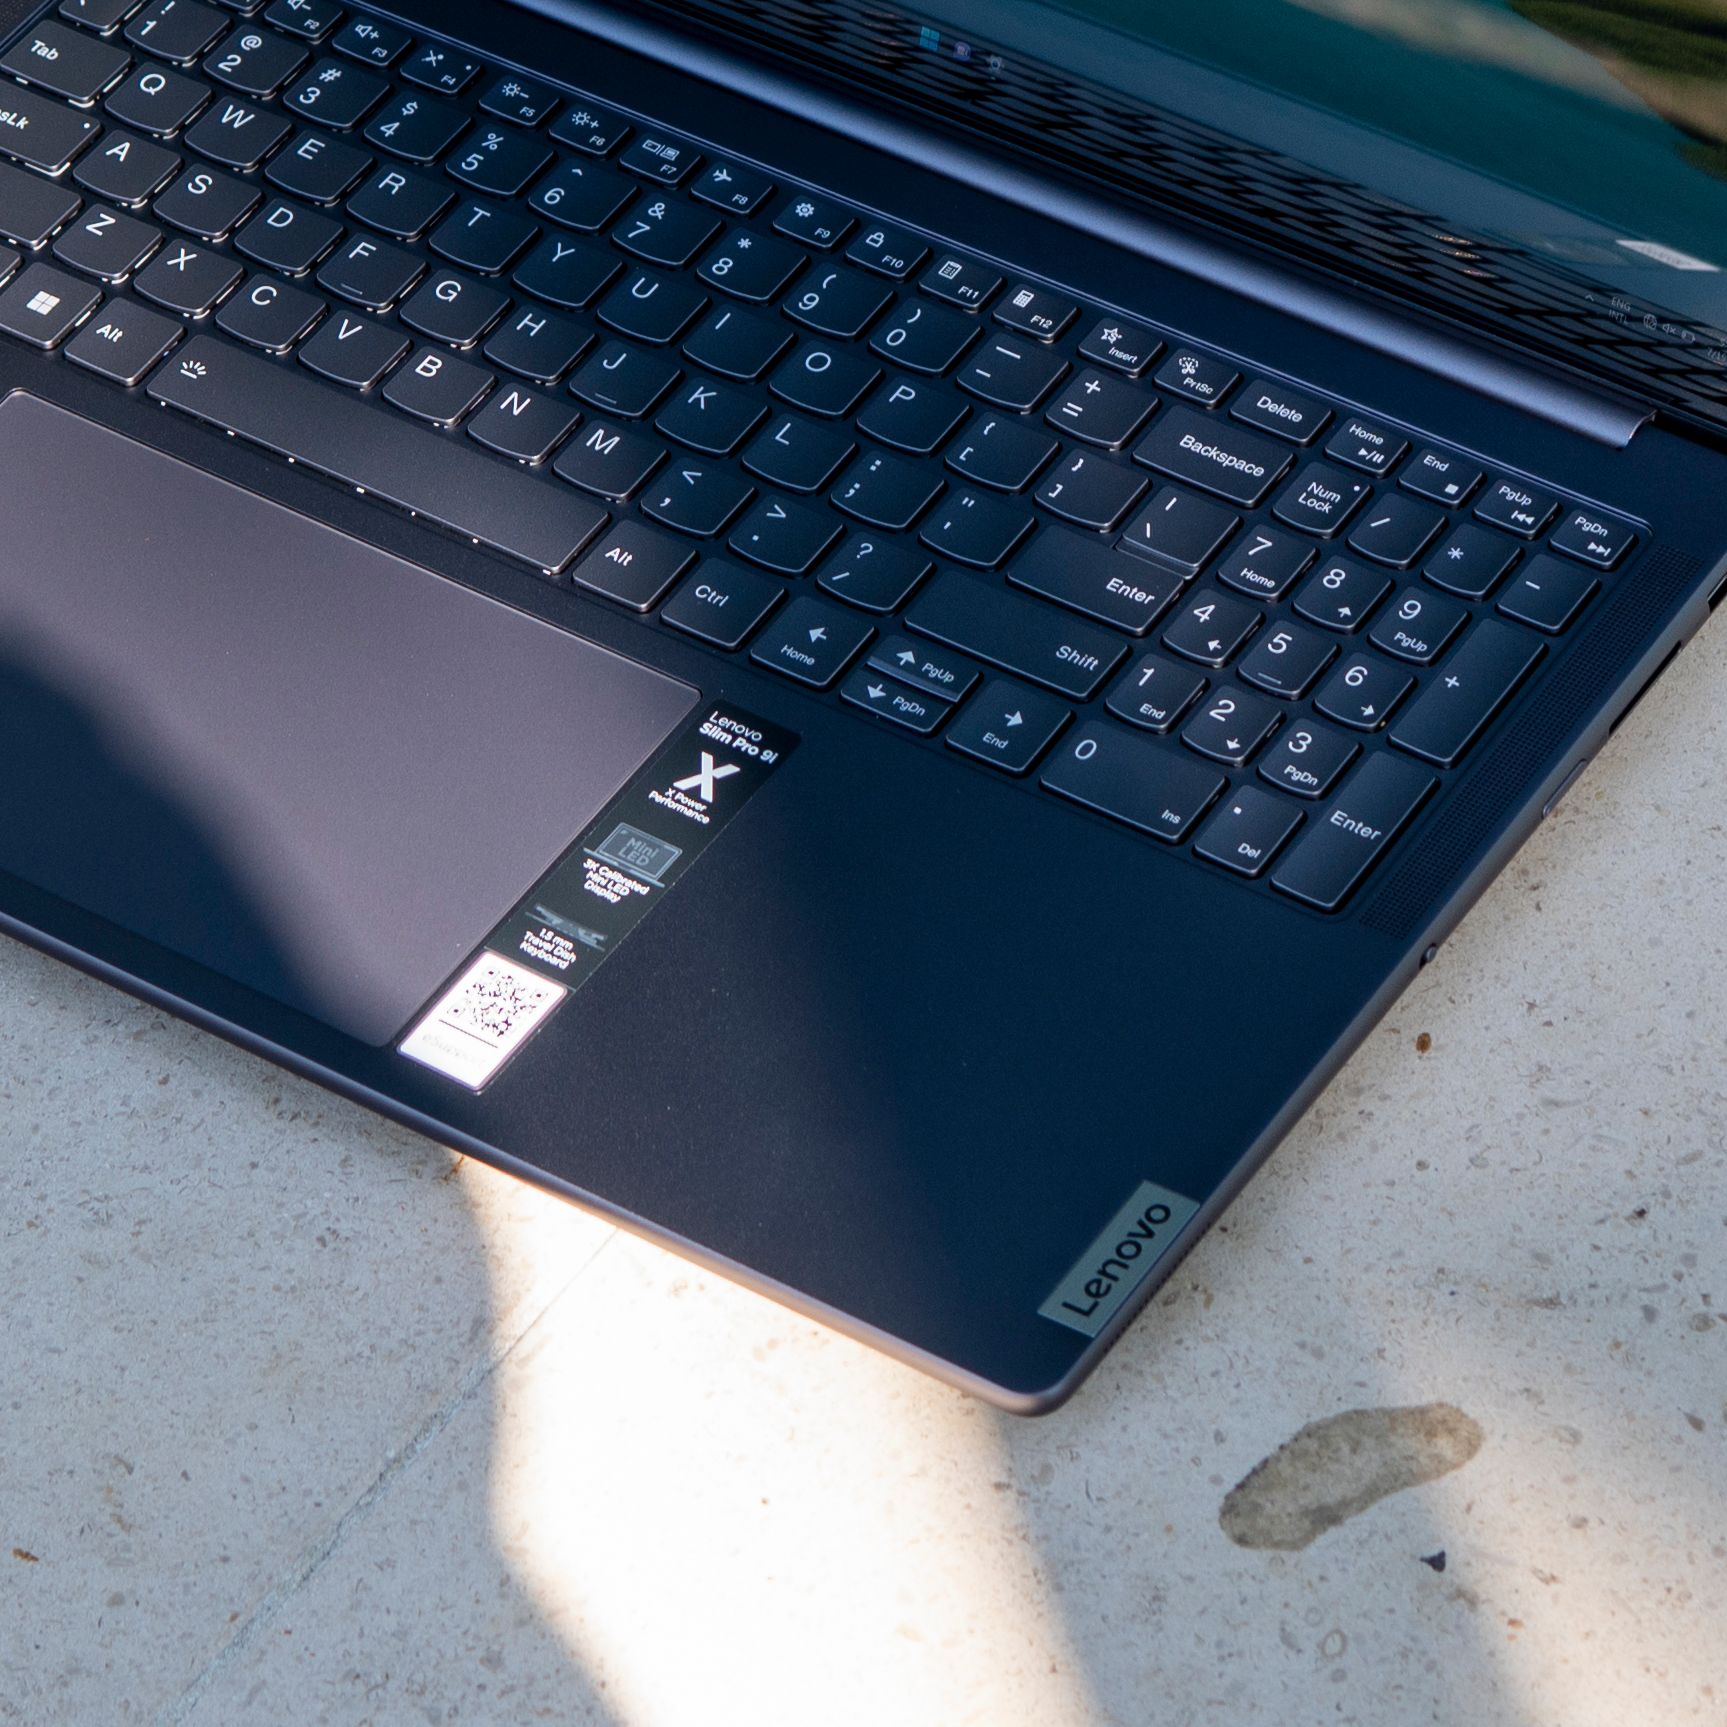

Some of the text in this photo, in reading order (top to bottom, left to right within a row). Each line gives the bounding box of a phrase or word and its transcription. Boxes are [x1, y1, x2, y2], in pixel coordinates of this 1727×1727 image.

[160, 0, 176, 15] !
[140, 20, 157, 36] 1
[303, 18, 320, 30] F2
[30, 39, 59, 61] Tab
[240, 34, 262, 51] @
[371, 46, 388, 58] F3
[217, 54, 242, 73] 2
[139, 73, 166, 96] Q
[318, 68, 342, 82] #
[440, 74, 457, 86] F4
[299, 86, 321, 105] 3
[221, 104, 255, 129] W
[401, 101, 418, 116] $
[519, 106, 536, 117] F5
[379, 121, 400, 138] 4
[296, 138, 326, 160] E
[481, 132, 504, 151] %
[589, 135, 606, 146] F6
[105, 141, 131, 162] A
[461, 153, 483, 171] 5
[659, 163, 677, 175] F7
[187, 174, 213, 195] S
[378, 172, 406, 195] R
[543, 187, 565, 205] 6
[731, 193, 749, 205] F8
[266, 206, 294, 228] D
[467, 206, 491, 227] T
[647, 202, 666, 220] &
[85, 212, 116, 236] Z
[627, 220, 651, 238] 7
[814, 227, 831, 239] F9
[165, 246, 199, 272] X
[348, 241, 377, 259] F
[551, 242, 576, 263] Y
[711, 257, 734, 275] 8
[881, 254, 904, 269] F10
[435, 280, 462, 303] G
[631, 277, 659, 299] U
[822, 273, 837, 289] (
[251, 285, 278, 306] C
[798, 292, 820, 311] 9
[957, 285, 980, 299] F11
[1611, 296, 1631, 313] ENG
[516, 312, 547, 337] H
[714, 312, 731, 330] I
[906, 308, 922, 324] )
[1030, 314, 1053, 329] F12
[95, 324, 123, 343] Alt
[337, 318, 363, 340] V
[885, 328, 907, 346] 0
[414, 354, 443, 378] B
[602, 352, 627, 370] J
[804, 351, 832, 373] O
[1107, 346, 1139, 367] Insert
[888, 384, 916, 403] P
[1084, 380, 1101, 394] +
[1179, 376, 1214, 398] PrtSc
[499, 391, 531, 416] N
[687, 386, 717, 410] K
[1062, 402, 1083, 417] =
[1252, 395, 1303, 427] Delete
[774, 422, 792, 445] L
[983, 422, 996, 436] {
[1348, 423, 1384, 445] Home
[585, 428, 621, 455] M
[959, 446, 974, 461] [
[1175, 434, 1265, 480] Backspace
[1423, 454, 1450, 472] End
[869, 459, 882, 472] :
[1071, 457, 1084, 472] }
[682, 470, 702, 485] <
[844, 482, 861, 498] ;
[1048, 483, 1064, 498] ]
[1305, 481, 1343, 504] Num
[1498, 485, 1532, 506] PgUp
[766, 503, 787, 519] >
[961, 496, 975, 508] "
[1296, 491, 1334, 515] Lock
[1574, 515, 1608, 537] PgDn
[856, 542, 874, 559] ?
[1248, 536, 1273, 556] 7
[604, 547, 633, 567] Alt
[831, 571, 850, 581] /
[1237, 567, 1276, 592] Home
[1322, 568, 1346, 589] 8
[694, 584, 729, 607] Ctrl
[1105, 577, 1155, 605] Enter
[1193, 604, 1216, 623] 4
[1398, 599, 1422, 620] 9
[1267, 632, 1293, 654] 5
[1390, 631, 1428, 656] PgUp
[780, 643, 816, 669] Home
[1055, 645, 1099, 671] Shift
[921, 662, 955, 683] PgUp
[1138, 668, 1155, 687] 1
[1344, 665, 1368, 687] 6
[892, 695, 926, 716] PgDn
[1136, 703, 1166, 724] End
[1208, 699, 1236, 722] 2
[708, 710, 763, 742] Lenovo
[699, 723, 779, 764] Slim Pro 9i
[982, 731, 1009, 749] End
[1074, 739, 1098, 760] 0
[1288, 731, 1313, 754] 3
[673, 751, 741, 803] X
[1280, 764, 1318, 790] PgDn
[648, 790, 711, 825] Performance
[664, 787, 708, 812] X Power
[1161, 809, 1181, 824] Ins
[1329, 809, 1382, 840] Enter
[618, 846, 650, 867] LED
[626, 837, 658, 858] Mini
[1237, 842, 1262, 859] Del
[583, 858, 650, 895] 3K Calibrated
[586, 871, 629, 897] Mini LED
[584, 880, 620, 903] Display
[523, 930, 551, 951] Travel
[551, 934, 573, 949] mm
[519, 941, 570, 970] Keyboard
[1062, 1203, 1171, 1317] Lenovo
